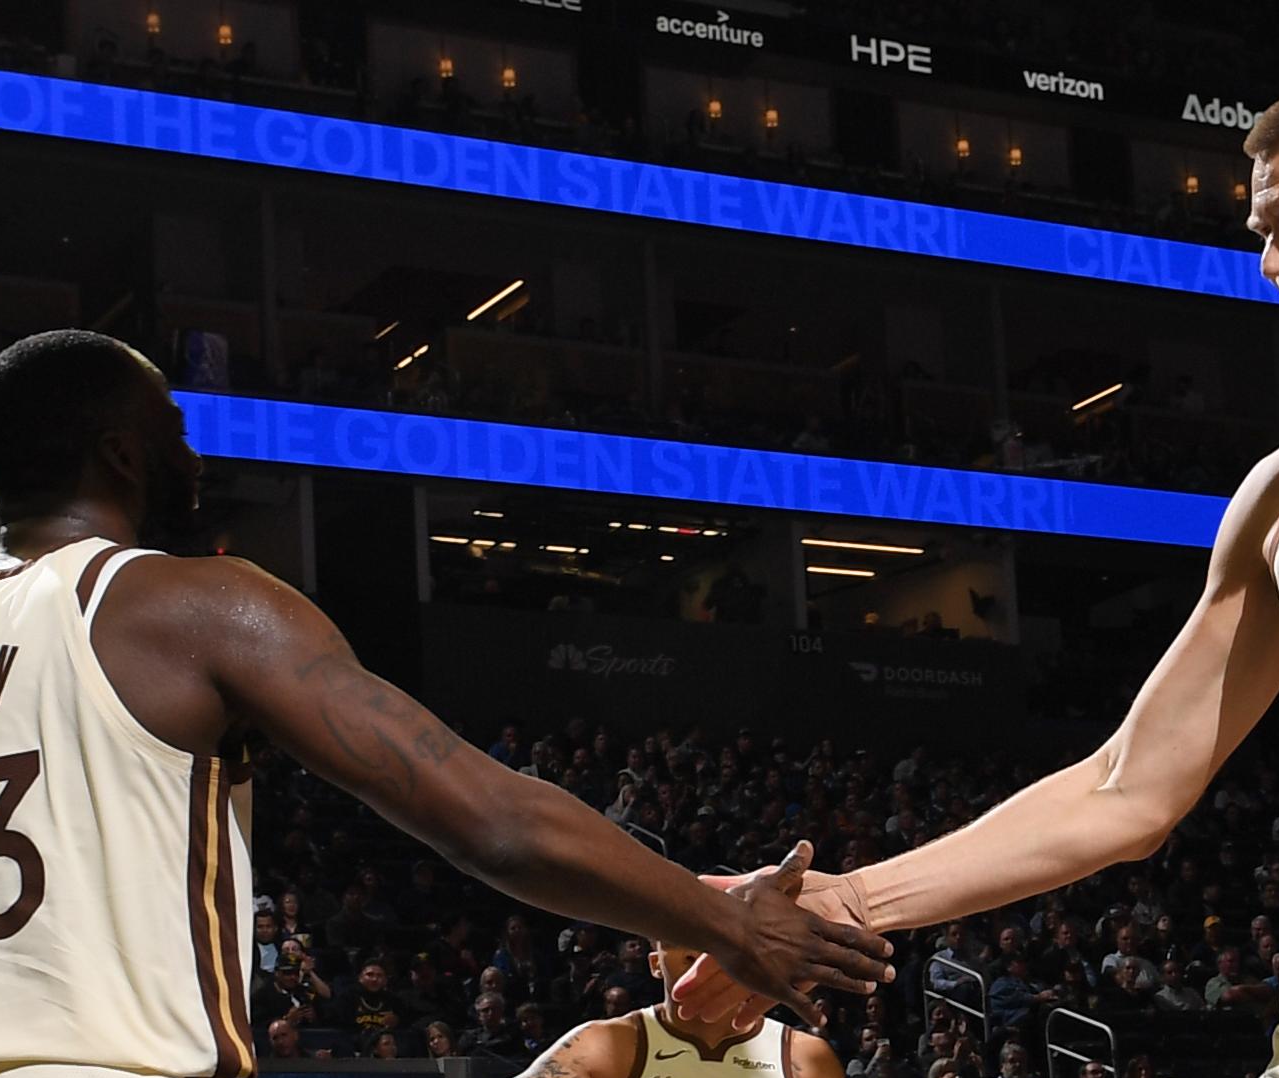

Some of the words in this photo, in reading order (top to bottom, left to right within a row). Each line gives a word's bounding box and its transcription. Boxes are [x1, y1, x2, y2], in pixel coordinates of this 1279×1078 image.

[655, 13, 765, 49] accenture
[850, 34, 933, 75] HPE
[1023, 69, 1104, 101] verizon
[98, 85, 236, 159] THE
[253, 108, 539, 200] GOLDEN
[557, 152, 743, 229] STATE
[754, 180, 958, 257] WARRI
[334, 407, 634, 494] GOLDEN
[650, 439, 845, 514] STATE
[854, 461, 1067, 533] WARRI
[789, 633, 822, 655] 104
[585, 645, 676, 678] Sports
[884, 664, 983, 687] DOORDASH
